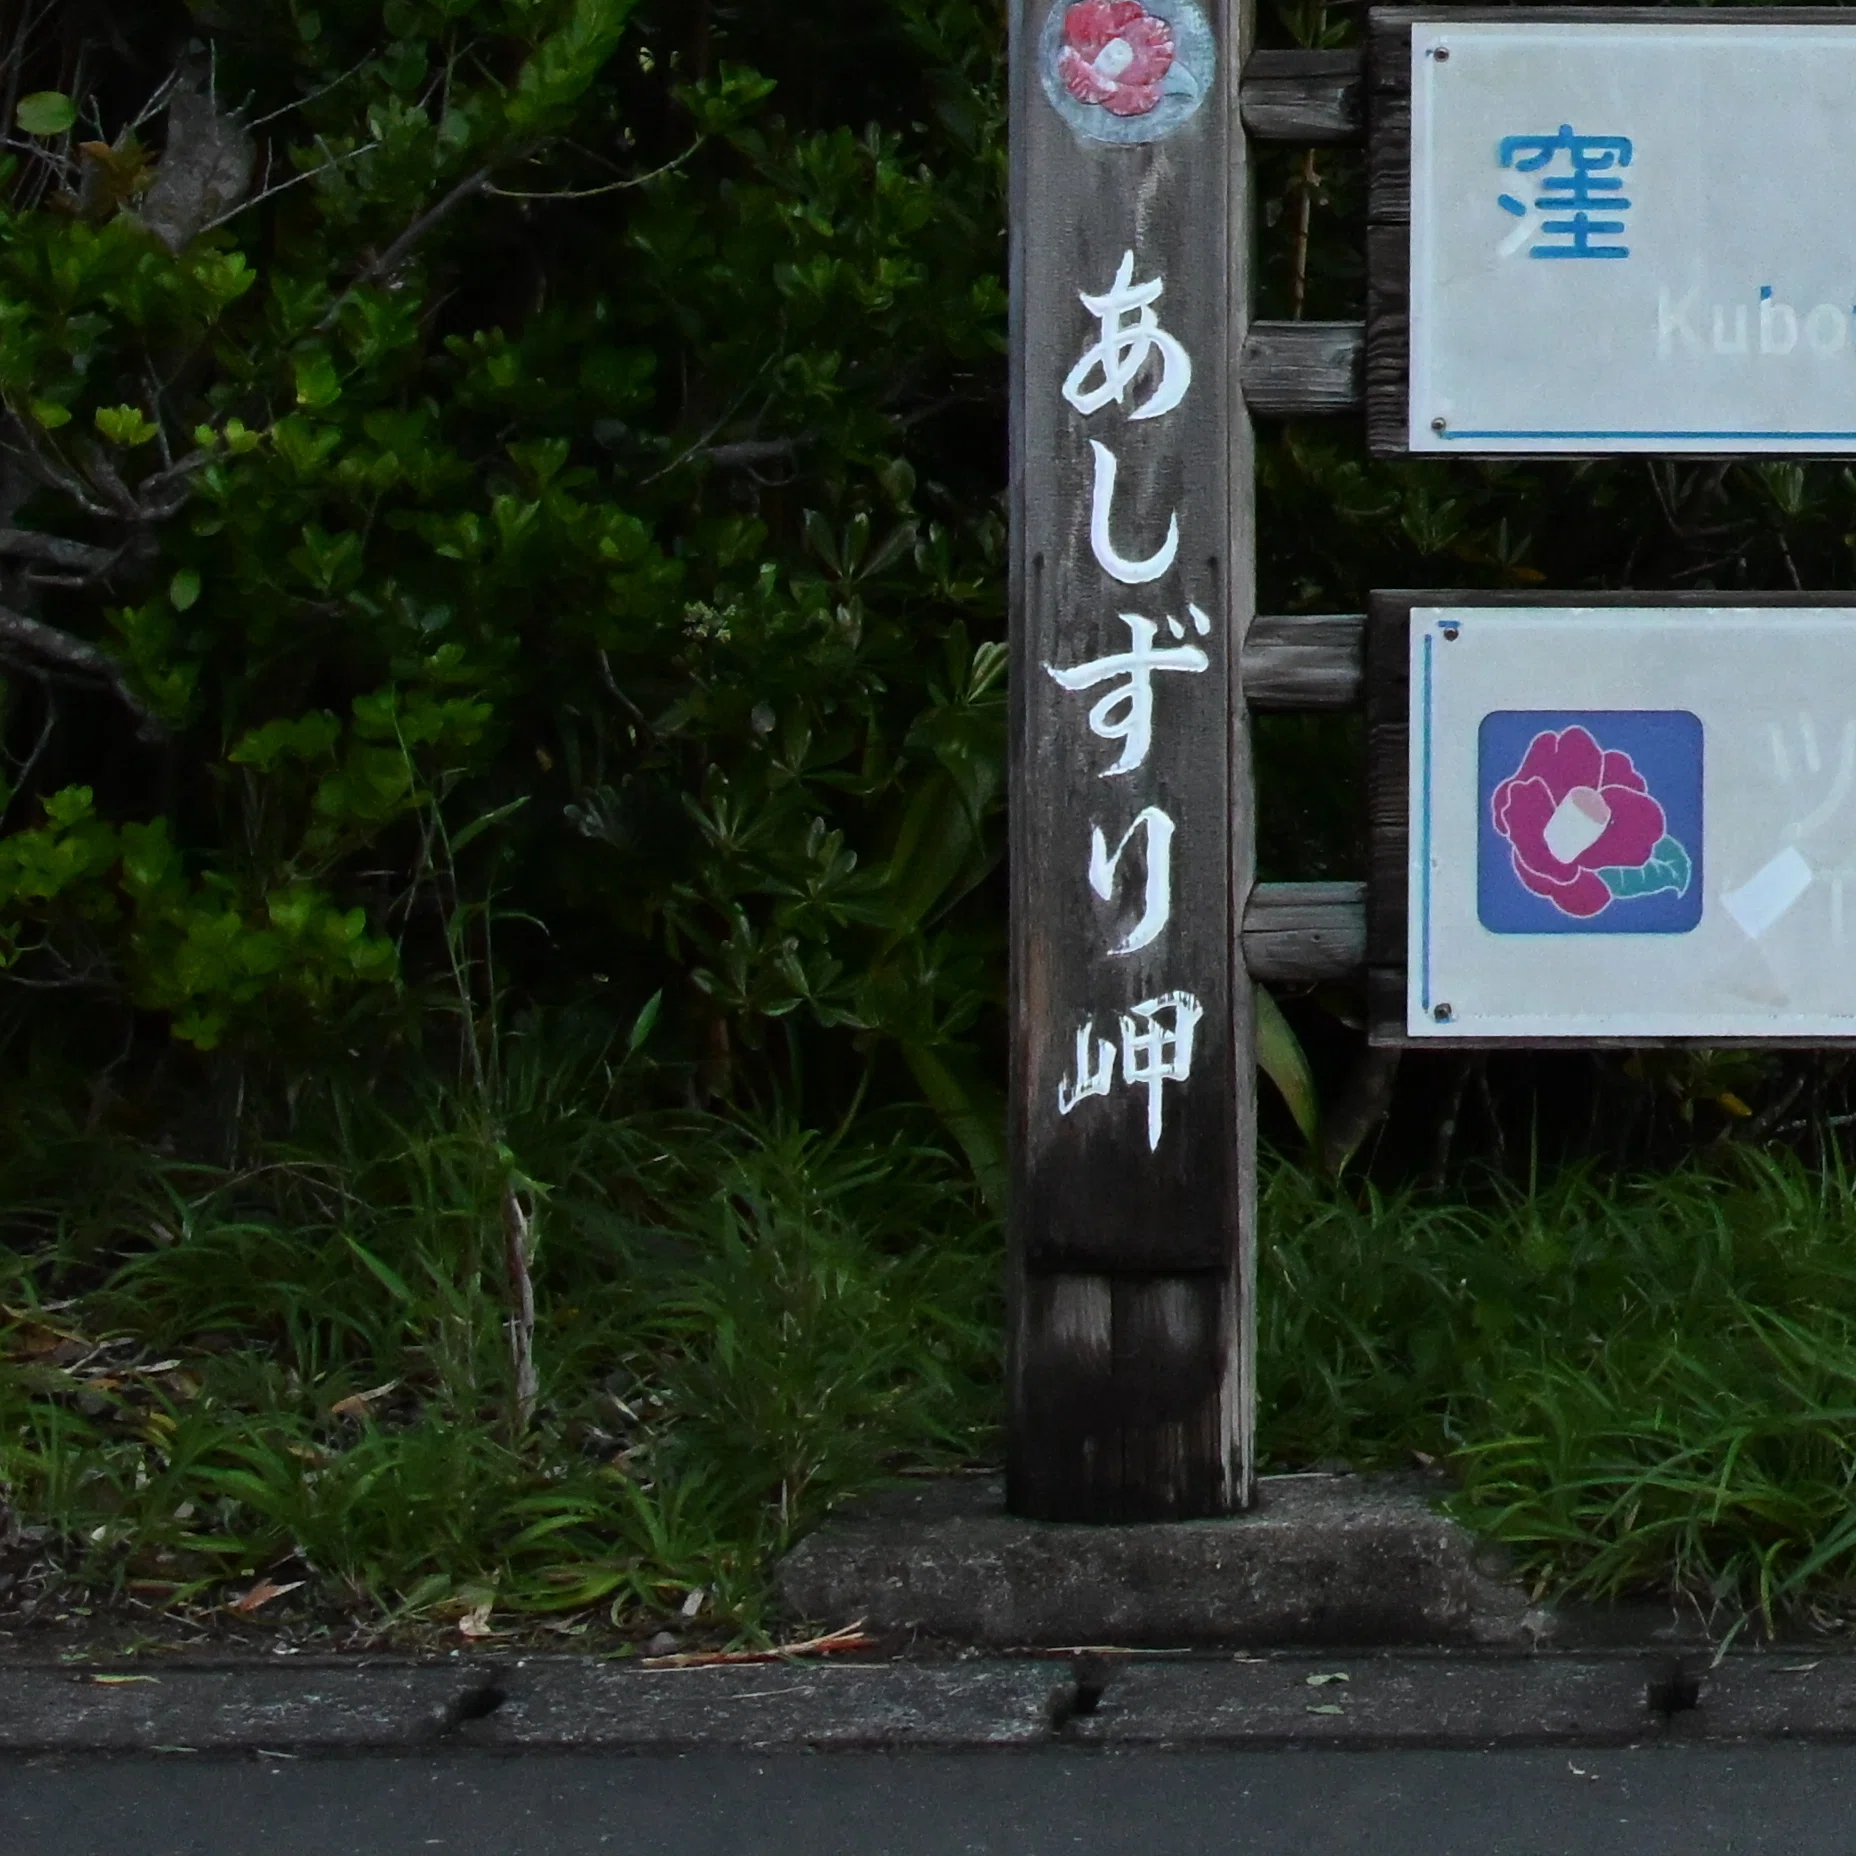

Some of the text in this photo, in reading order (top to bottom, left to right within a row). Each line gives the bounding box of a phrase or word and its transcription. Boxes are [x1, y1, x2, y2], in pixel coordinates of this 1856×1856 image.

[1040, 247, 1210, 1152] あしずり岬
